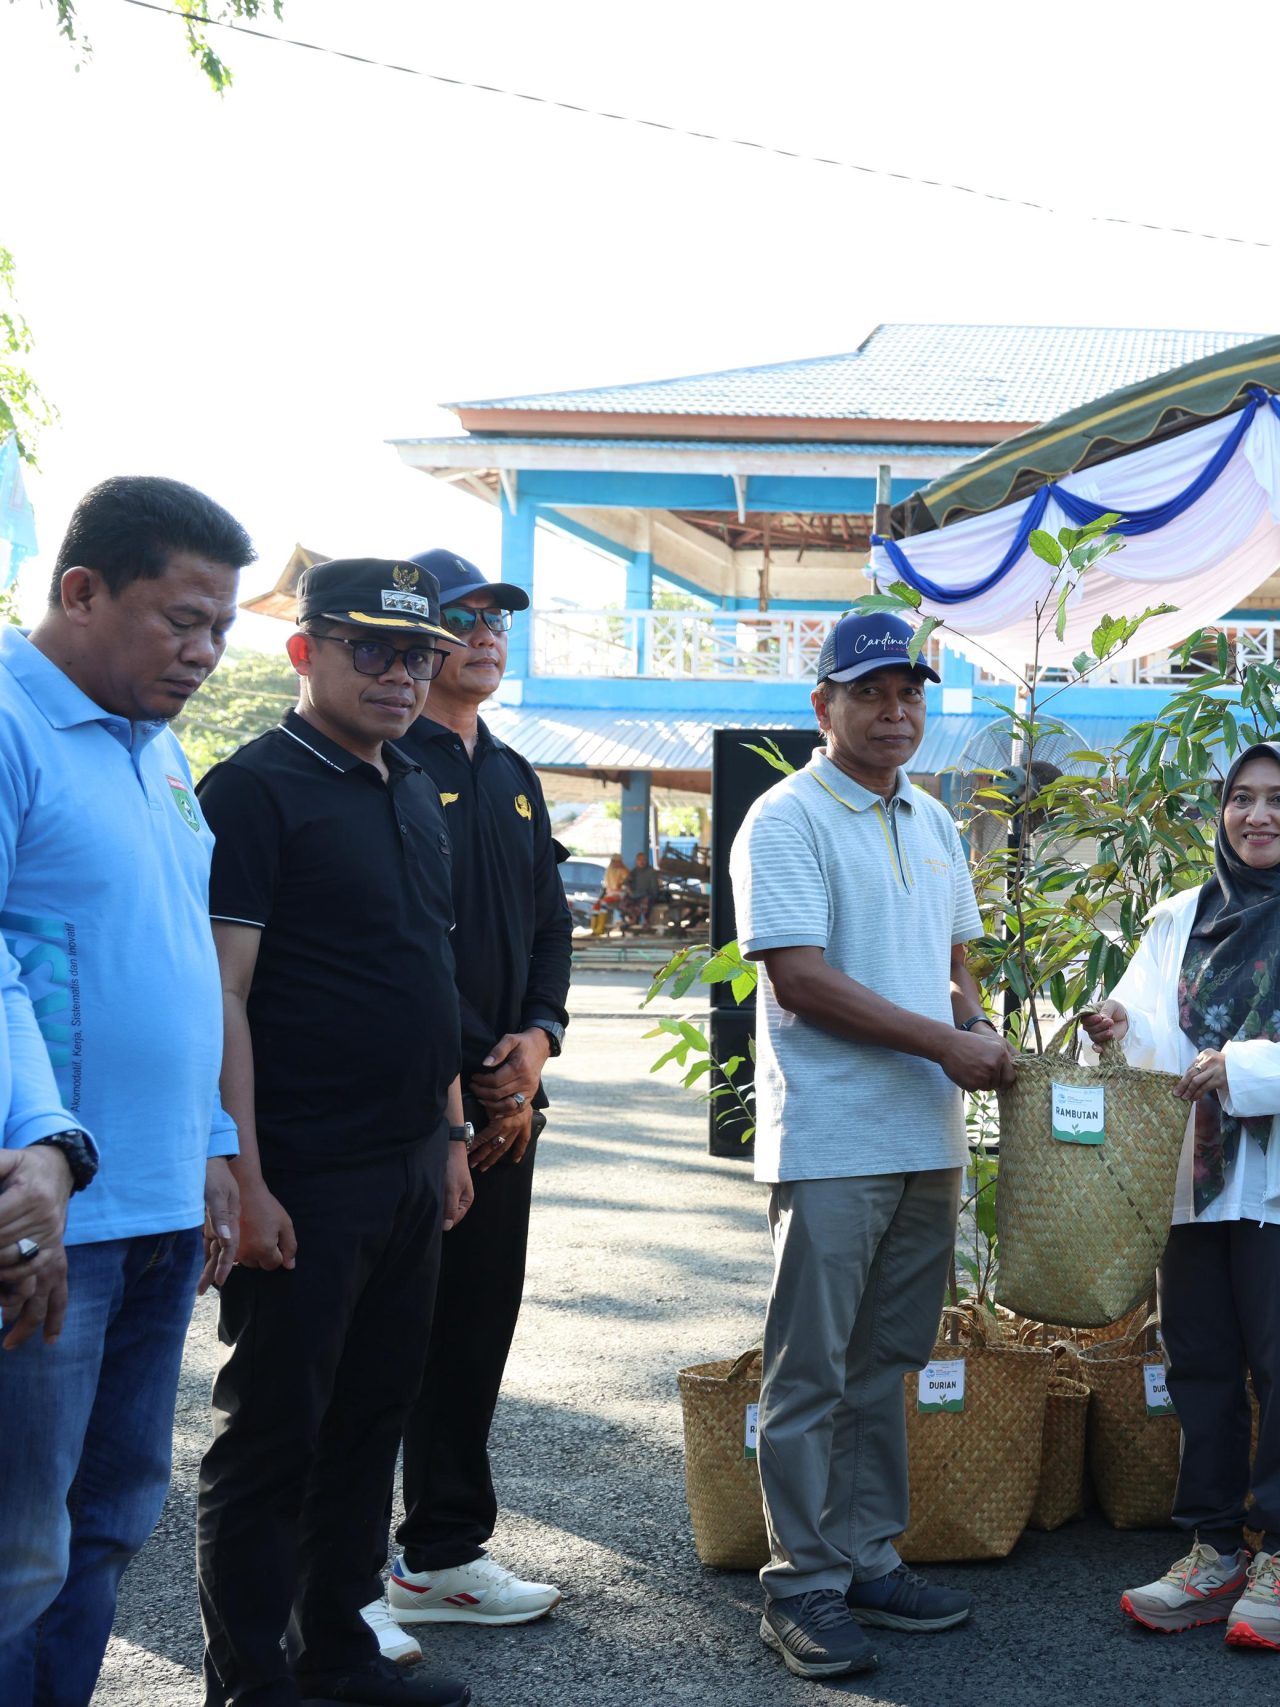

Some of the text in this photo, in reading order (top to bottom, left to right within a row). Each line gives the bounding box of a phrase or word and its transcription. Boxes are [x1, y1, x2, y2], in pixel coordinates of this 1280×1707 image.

[855, 632, 909, 654] Cardinal
[64, 922, 77, 957] Inovatif
[68, 958, 79, 977] dan
[70, 978, 81, 1027] Sistematis
[1055, 1106, 1099, 1120] RAMBUTAN
[929, 1381, 957, 1390] DURIAN
[1153, 1385, 1167, 1393] DUR
